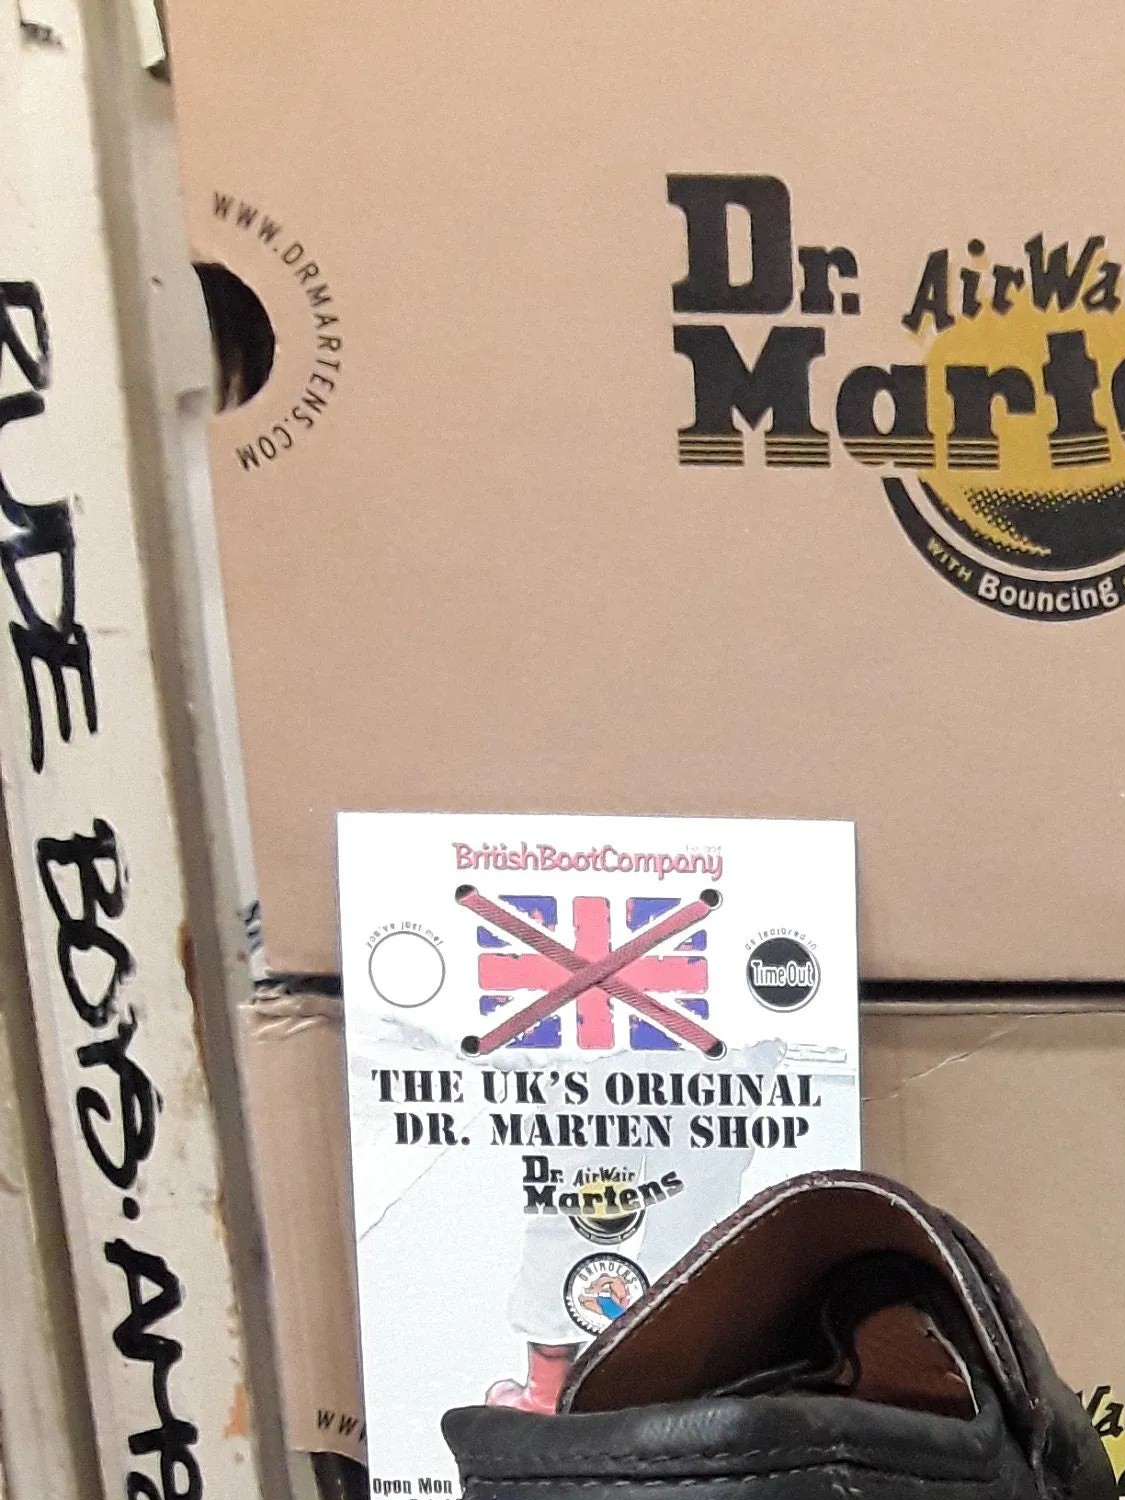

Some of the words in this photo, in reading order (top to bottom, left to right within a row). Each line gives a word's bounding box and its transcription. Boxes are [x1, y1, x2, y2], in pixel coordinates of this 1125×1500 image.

[666, 173, 861, 316] Dr.
[212, 191, 343, 472] WWW.DRMARTENS.COM
[927, 536, 973, 583] WITH
[977, 572, 1121, 614] Bouncing
[453, 842, 723, 881] BritishBootCompany
[371, 1069, 464, 1103] THE
[482, 1070, 589, 1106] UK'S
[604, 1072, 823, 1108] ORIGINAL
[394, 1112, 470, 1146] DR.
[489, 1113, 672, 1149] MARTEN
[690, 1116, 810, 1149] SHOP
[522, 1155, 563, 1183] Dr.
[573, 1166, 635, 1187] AirWair
[523, 1170, 685, 1214] Martens
[418, 1478, 453, 1495] Mon
